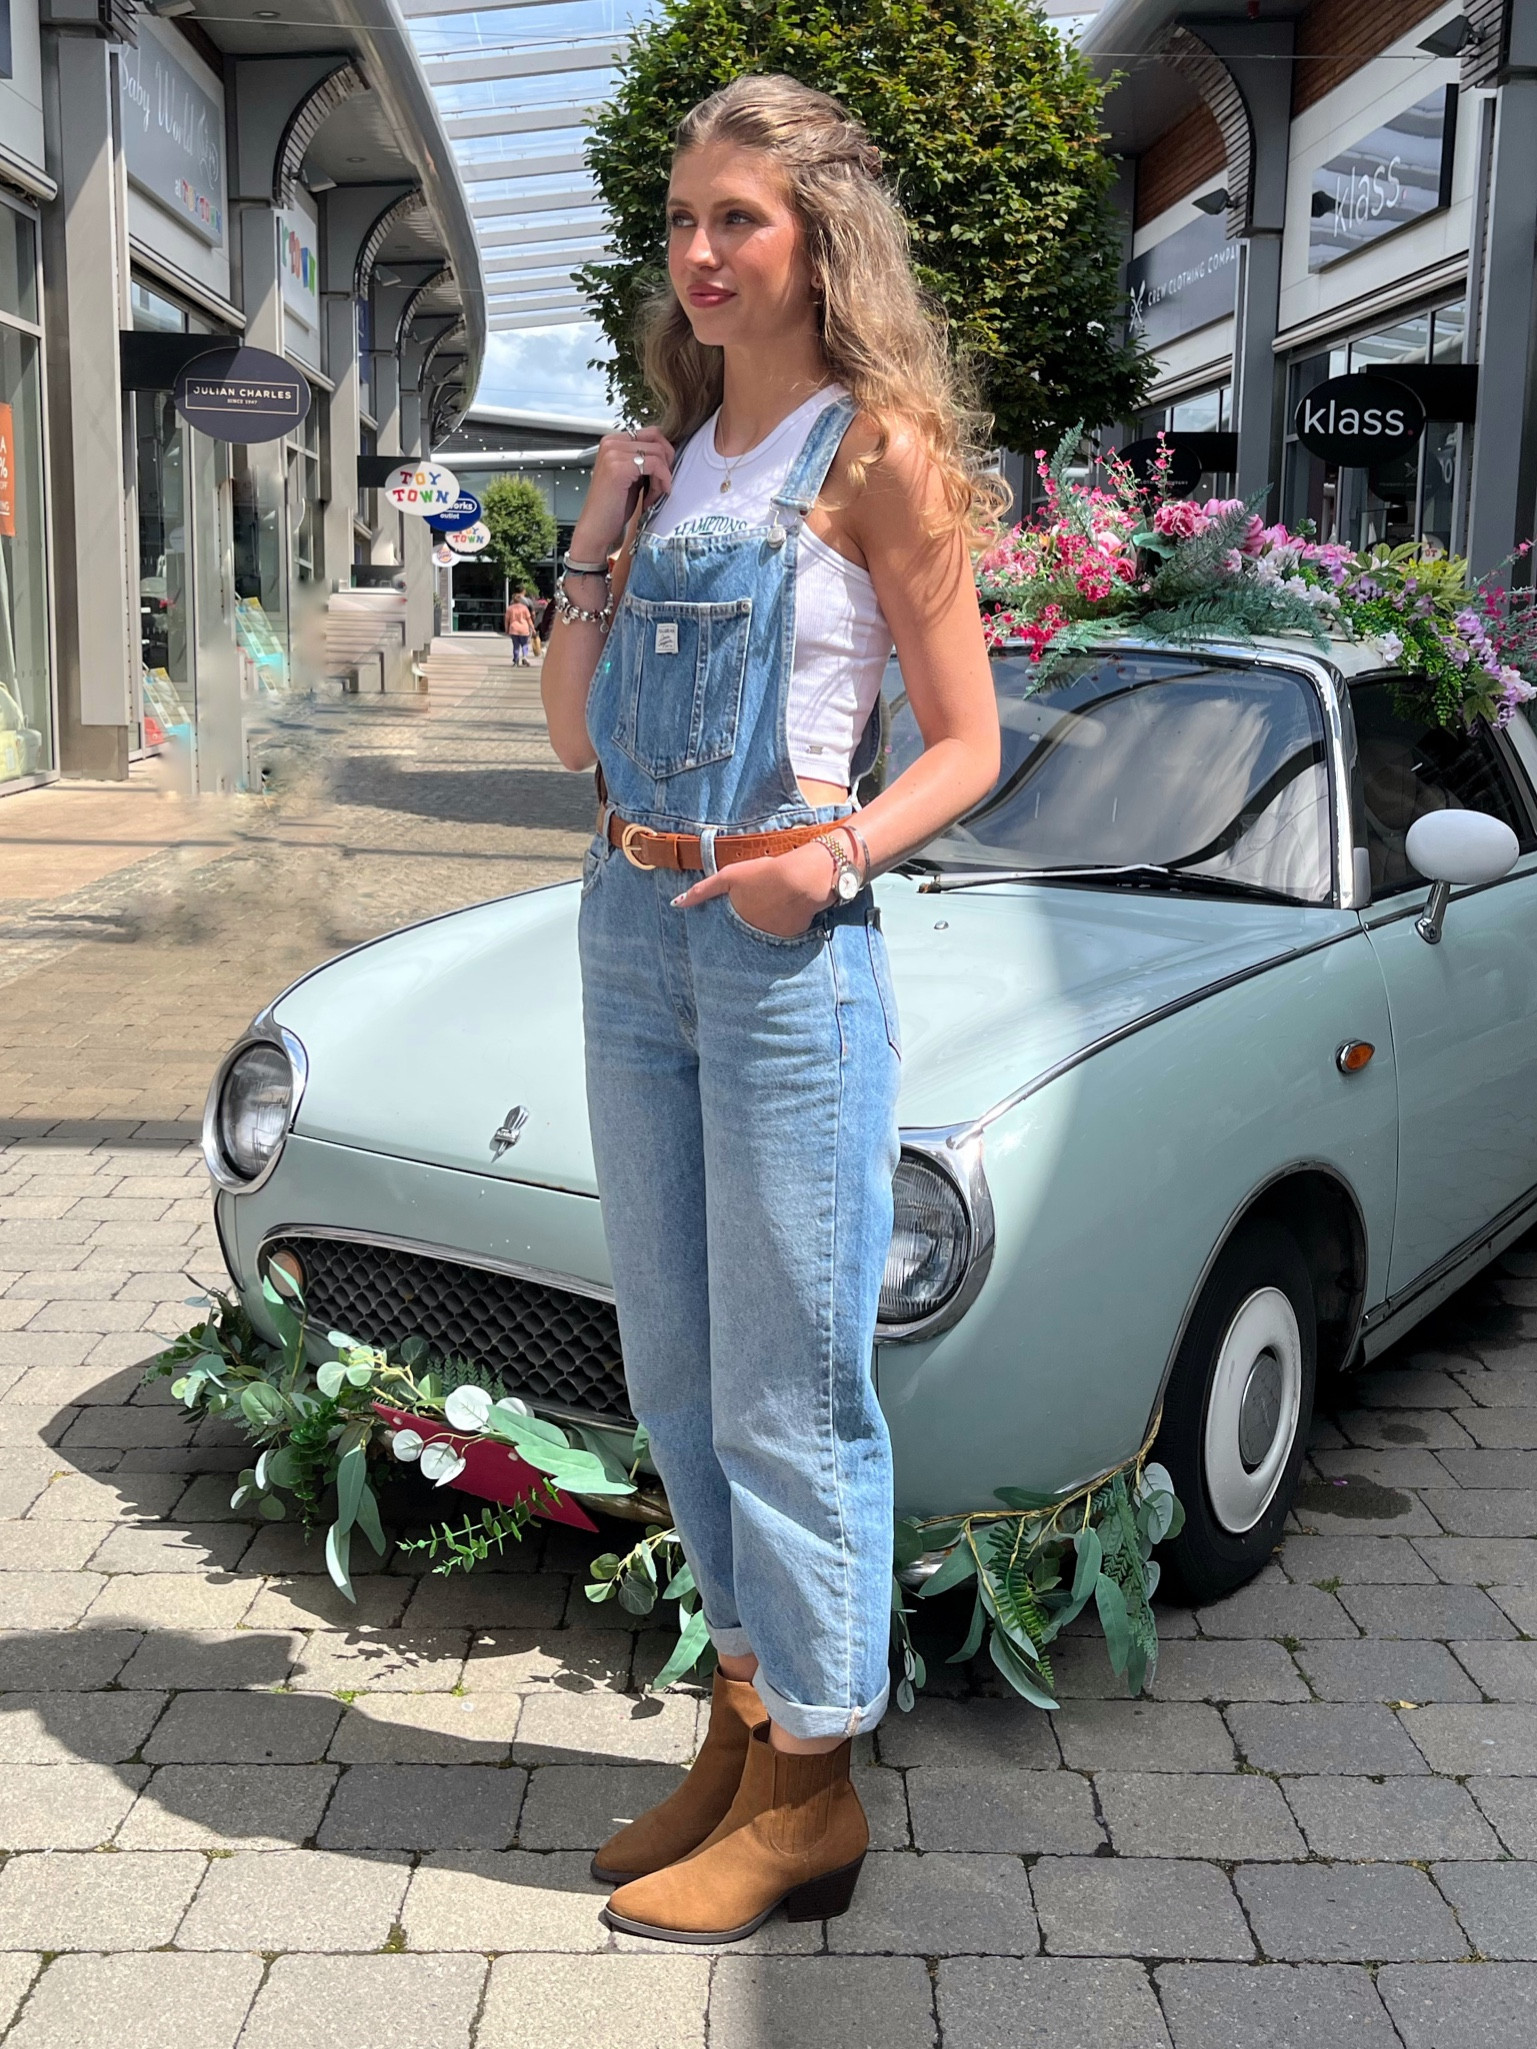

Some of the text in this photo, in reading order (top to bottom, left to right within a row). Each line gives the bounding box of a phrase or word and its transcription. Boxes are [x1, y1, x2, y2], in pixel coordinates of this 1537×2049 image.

[155, 61, 194, 156] World
[1147, 283, 1167, 307] CREW
[1168, 261, 1206, 295] CLOTHING
[193, 386, 292, 400] JULIAN CHARLES
[400, 471, 441, 485] TOY
[392, 489, 449, 504] TOWN
[440, 512, 460, 520] outlet
[453, 535, 484, 544] TOWN
